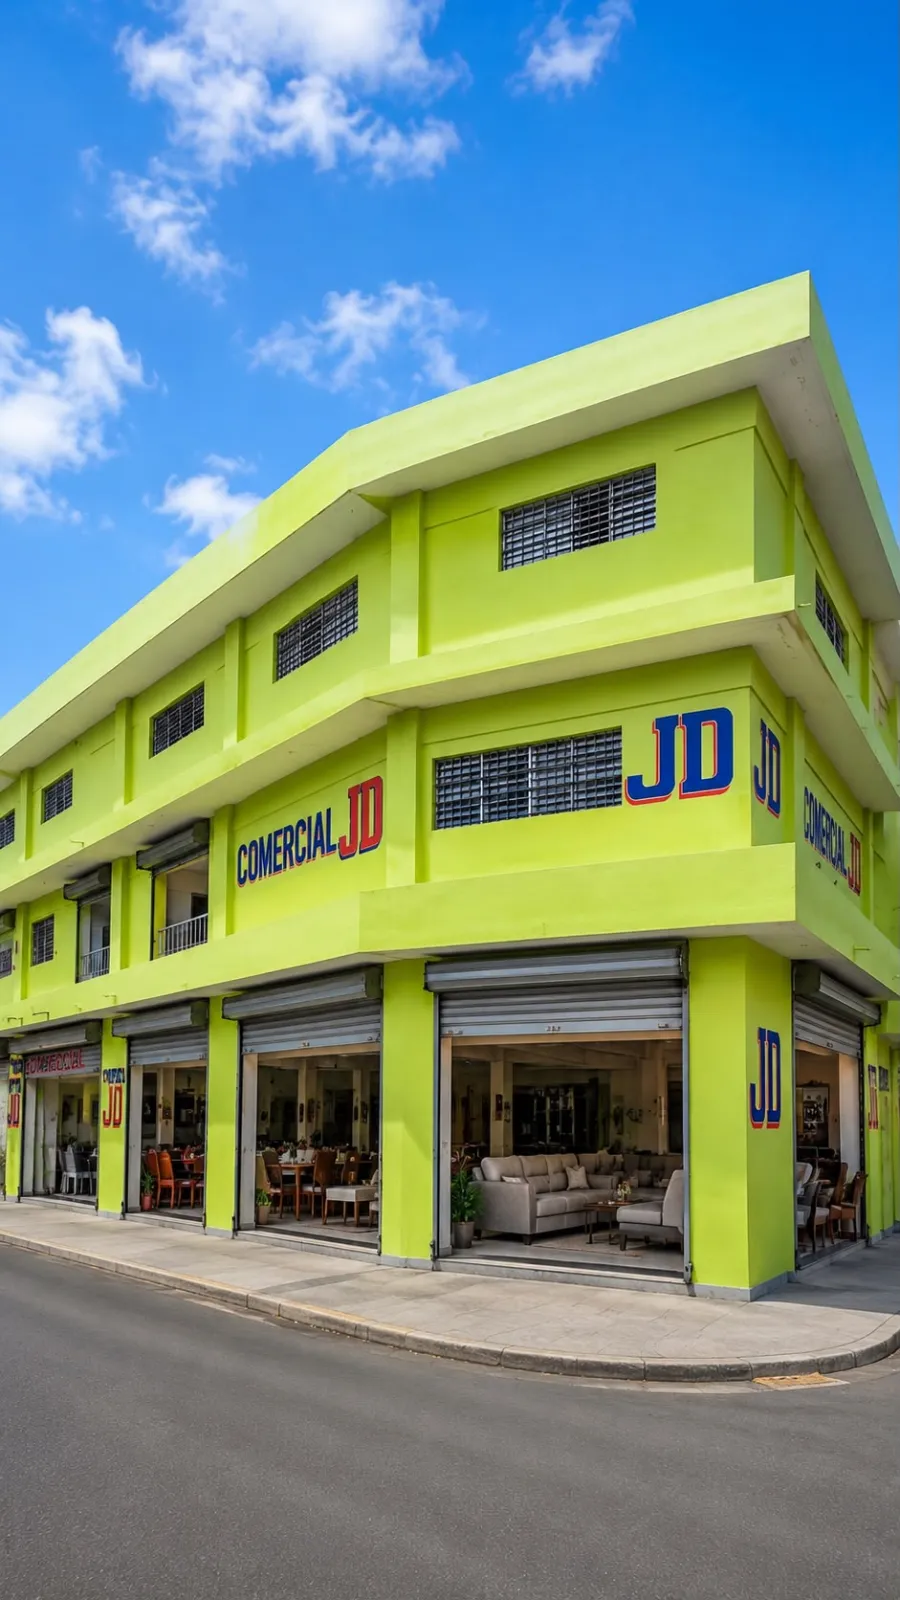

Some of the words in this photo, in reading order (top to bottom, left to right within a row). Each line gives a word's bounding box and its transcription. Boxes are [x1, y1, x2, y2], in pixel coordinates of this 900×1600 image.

[624, 707, 734, 806] JD
[754, 718, 781, 819] JD
[237, 807, 337, 888] COMERCIAL
[338, 775, 384, 861] JD
[804, 786, 847, 879] COMERCIAL
[848, 831, 861, 896] JD
[102, 1084, 123, 1128] JD
[749, 1026, 781, 1129] JD
